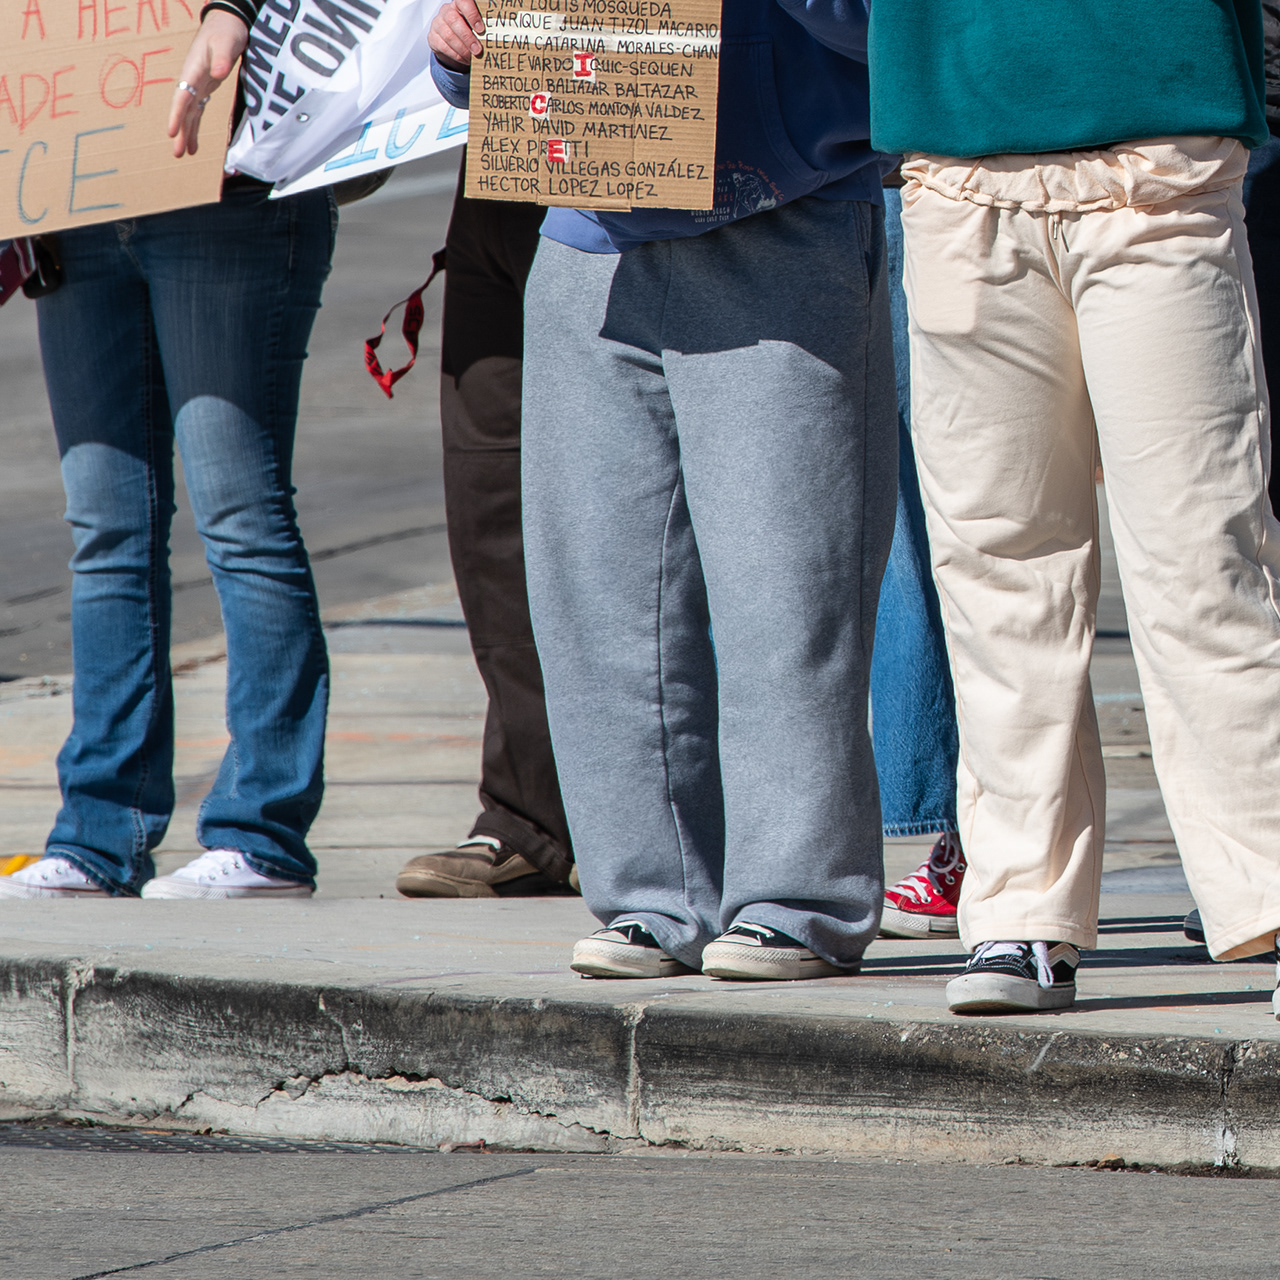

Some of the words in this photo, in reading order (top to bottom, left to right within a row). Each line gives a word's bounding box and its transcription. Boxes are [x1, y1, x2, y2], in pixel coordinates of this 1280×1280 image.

[583, 0, 672, 19] MOSQUEDA
[486, 10, 552, 30] ENRIQUE
[559, 14, 604, 33] JUAN
[611, 17, 653, 36] TIZOL
[658, 20, 718, 38] MACARIO
[485, 33, 530, 51] ELENA
[535, 36, 606, 53] CATARINA
[617, 40, 719, 59] MORALES-CHAN
[0, 65, 79, 135] ADE
[100, 47, 175, 109] OF
[483, 75, 540, 92] BARTOLO
[546, 78, 610, 97] BALTAZAR
[615, 83, 698, 100] BALTAZAR
[482, 94, 530, 111] ROBERTO
[530, 95, 584, 115] CARLOS
[588, 101, 642, 118] MONTOYA
[646, 105, 705, 121] VALDEZ
[483, 113, 525, 134] YAHIR
[532, 118, 575, 136] DAVID
[582, 122, 673, 141] MARTINEZ
[481, 137, 520, 154] ALEX
[528, 139, 589, 163] PRETTI
[0, 124, 126, 225] CE
[481, 155, 539, 173] SILVERIO
[545, 159, 621, 177] VILLEGAS
[478, 176, 541, 194] HECTOR
[550, 178, 600, 197] LOPEZ
[607, 181, 658, 200] LOPEZ
